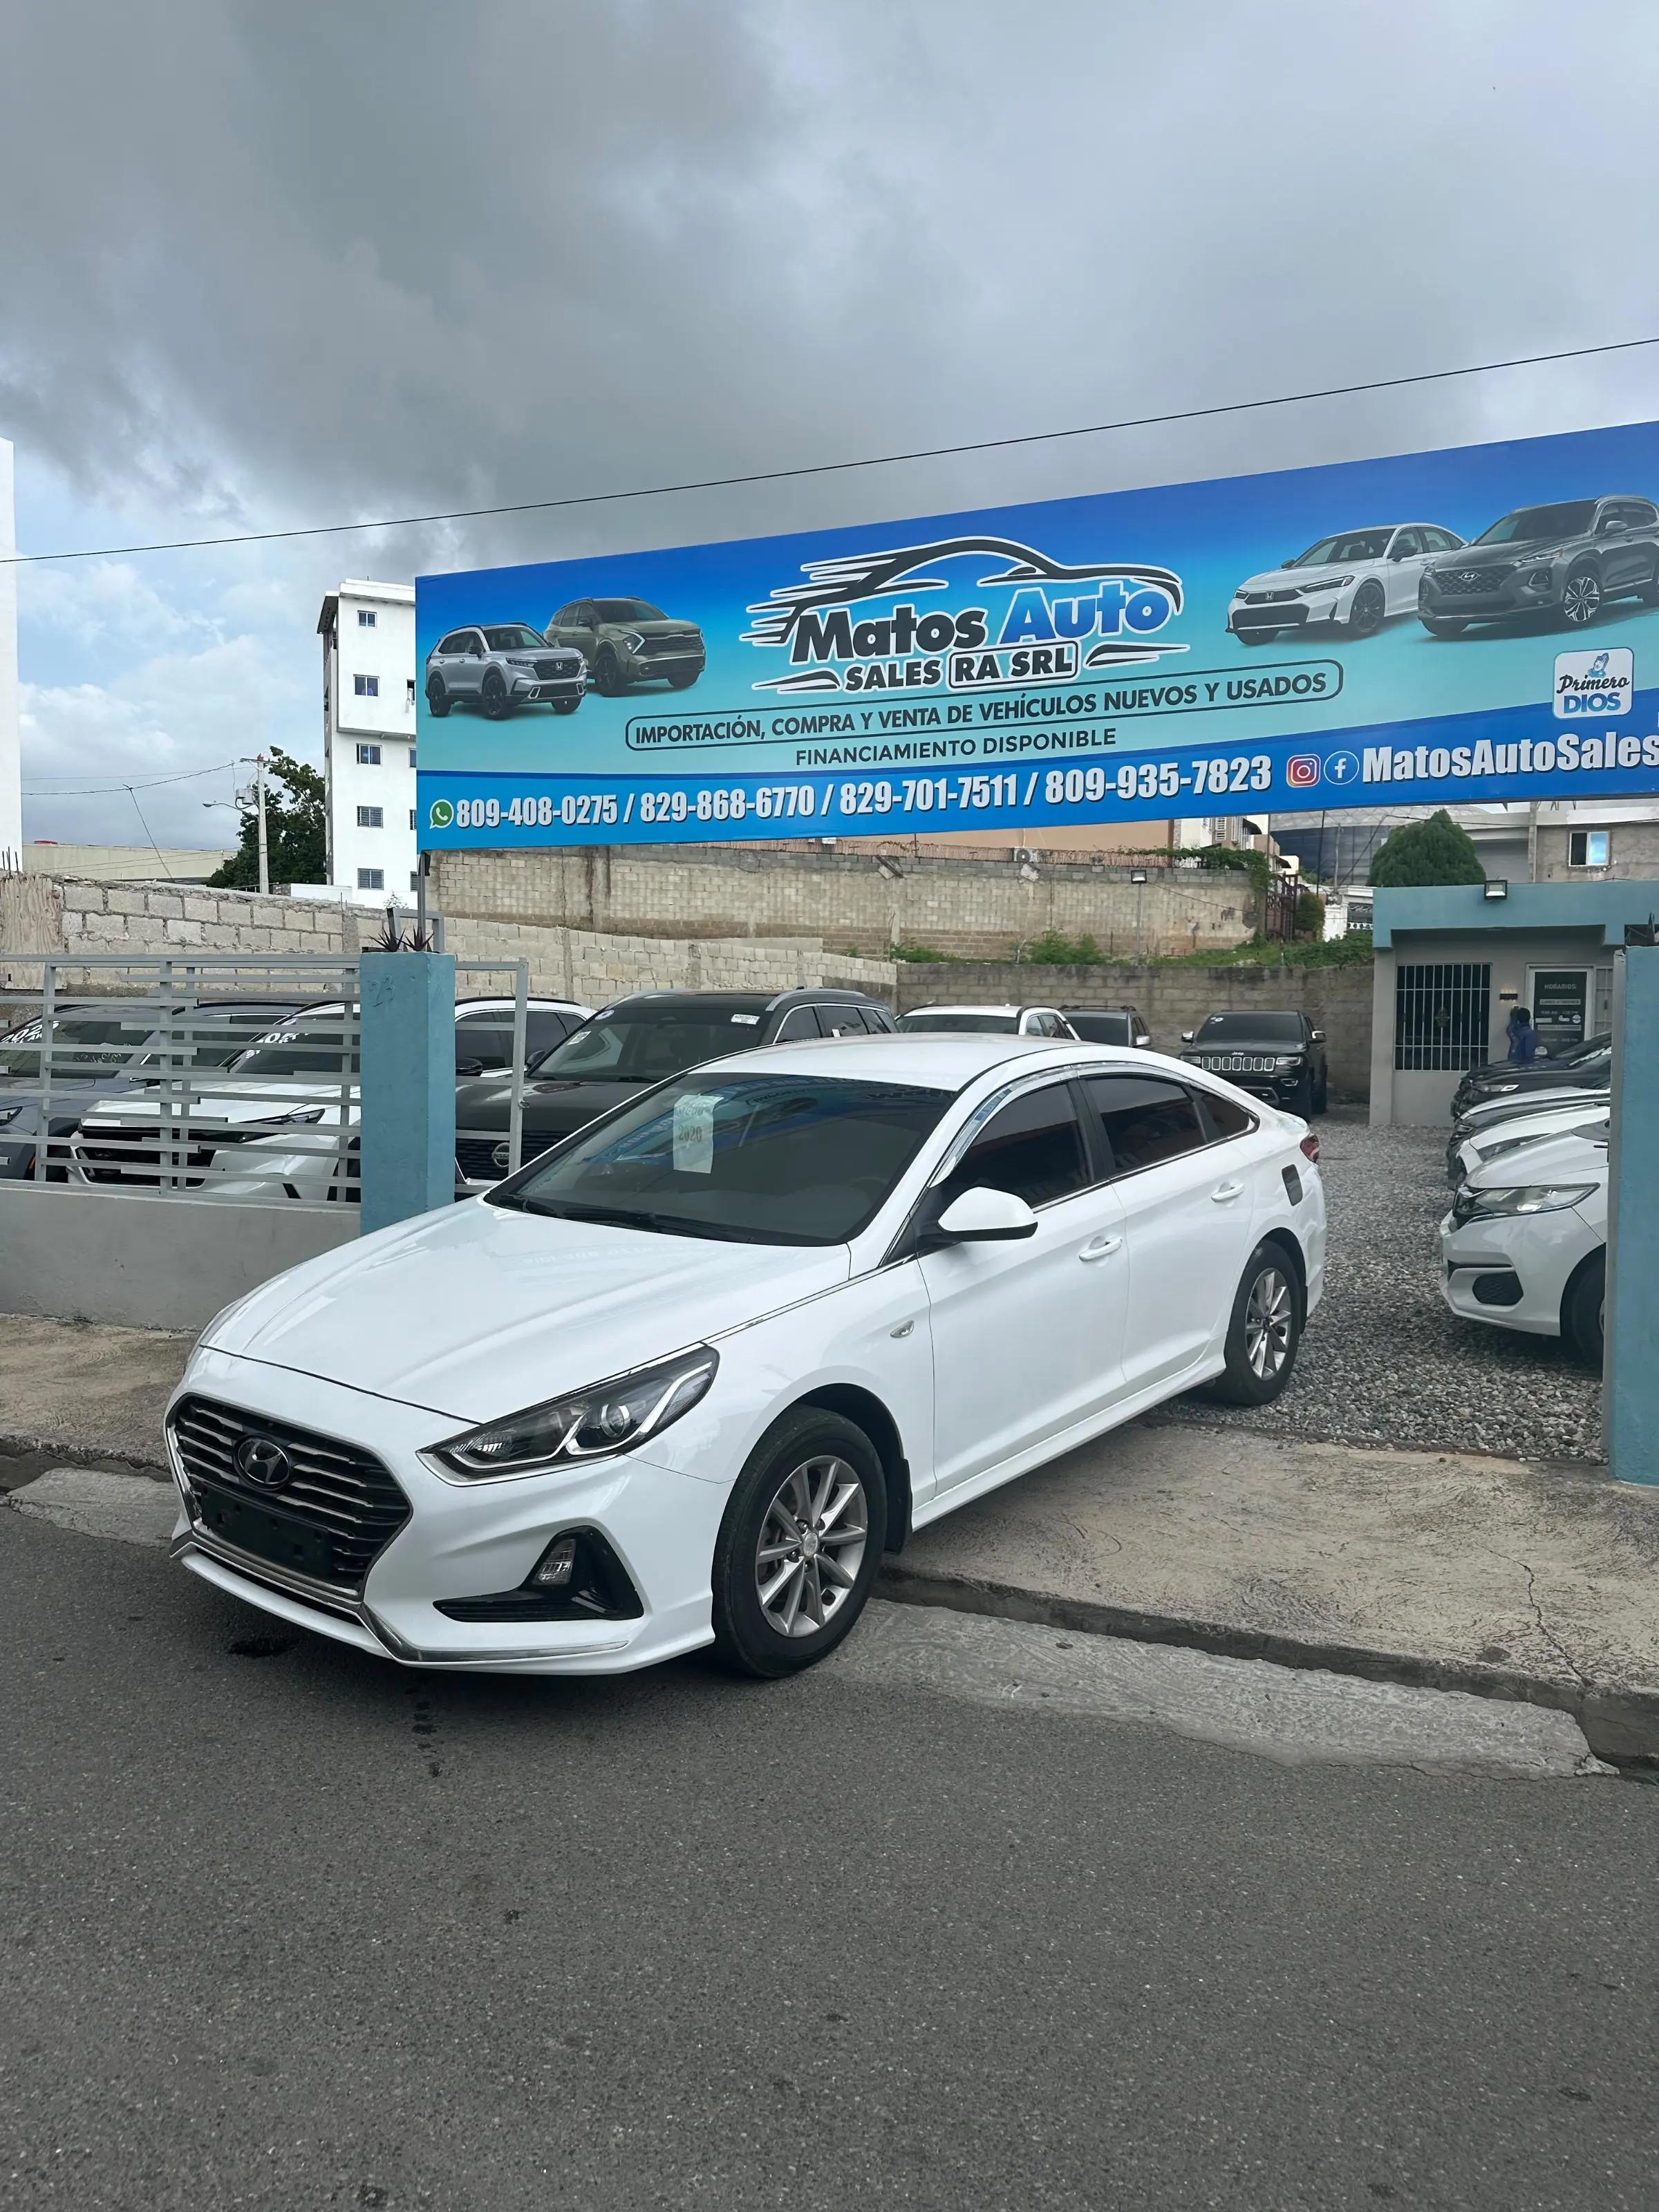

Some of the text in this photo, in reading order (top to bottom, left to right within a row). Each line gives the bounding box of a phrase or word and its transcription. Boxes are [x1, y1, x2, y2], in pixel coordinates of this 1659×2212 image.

[792, 584, 1170, 663] Matos Auto
[845, 648, 1072, 691] SALES RA SRL
[1556, 674, 1631, 694] Primero
[636, 673, 1327, 744] IMPORTACIÓN, COMPRA Y VENTA DE VEHÍCULOS NUEVOS Y USADOS
[1563, 692, 1622, 714] DIOS
[796, 728, 1117, 766] FINANCIAMIENTO DISPONIBLE
[456, 794, 618, 827] 809-408-0275
[640, 785, 816, 823] 829-868-6770
[839, 774, 1018, 816] 829-701-7511
[1044, 755, 1273, 804] 809-935-7823
[1362, 731, 1659, 783] MatosAutoSales
[678, 1123, 703, 1143] 2020
